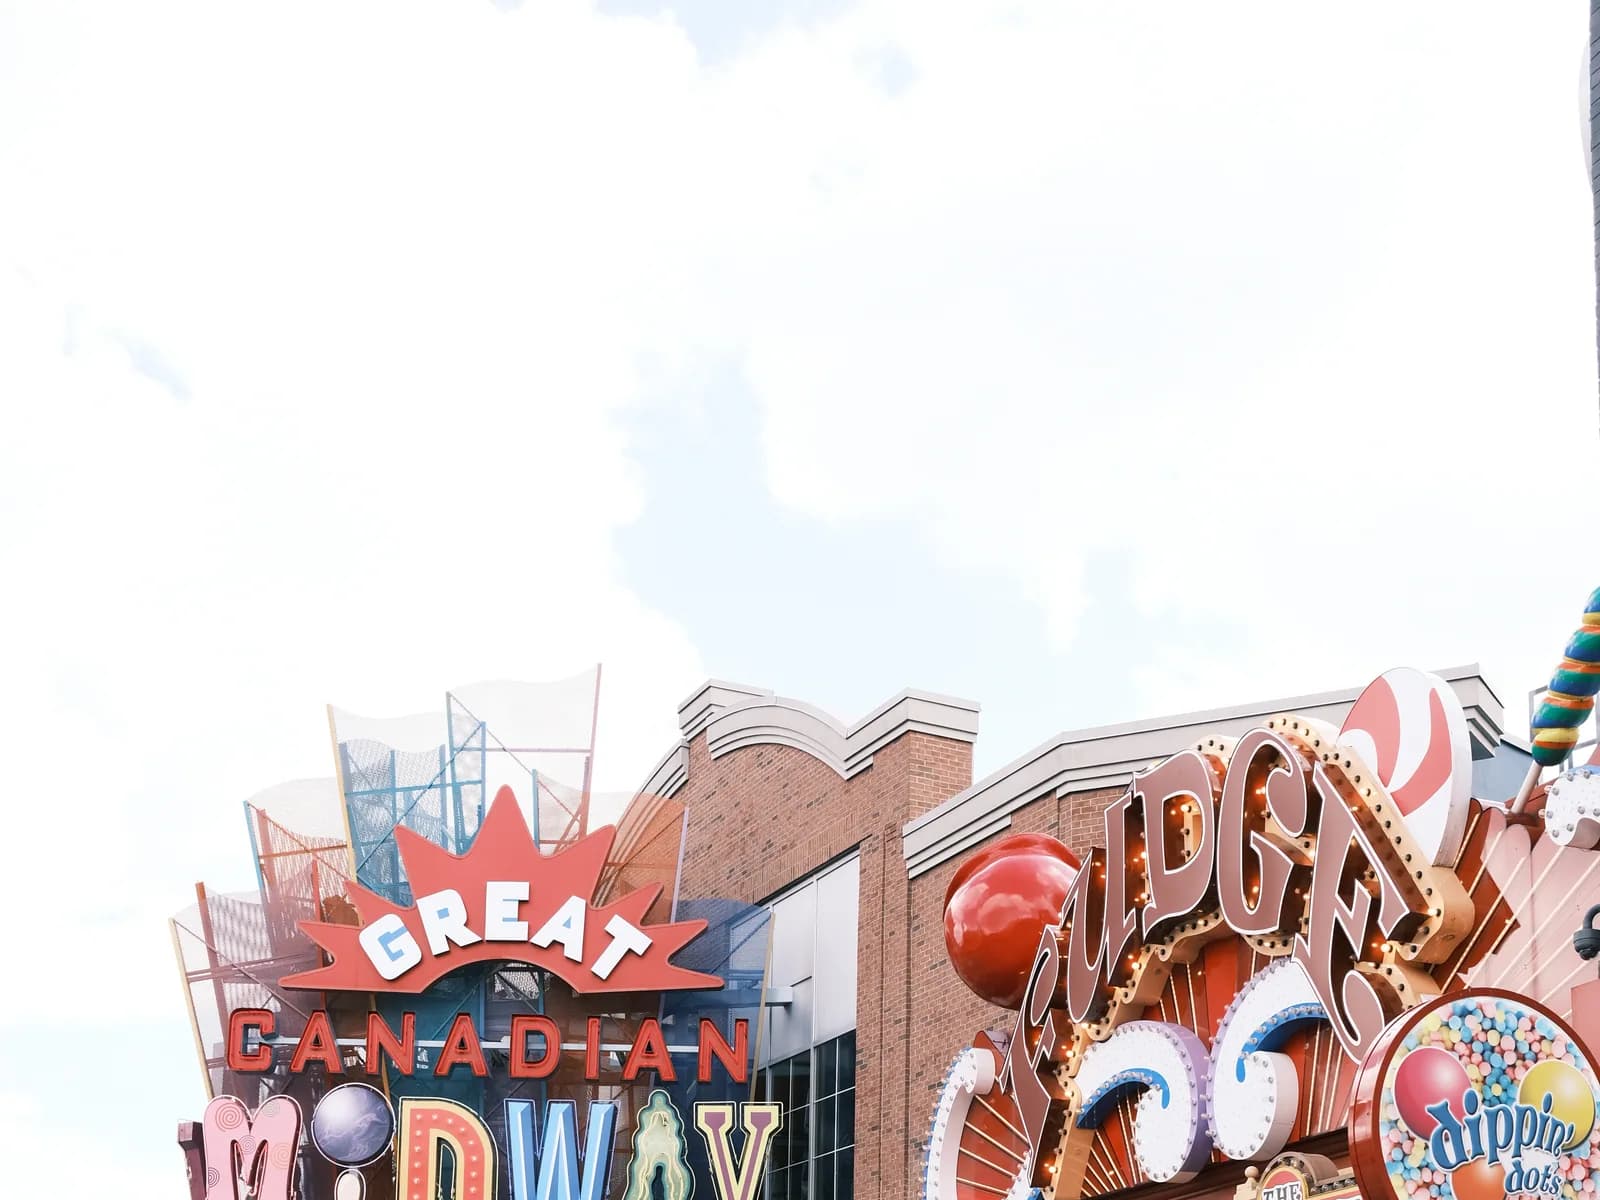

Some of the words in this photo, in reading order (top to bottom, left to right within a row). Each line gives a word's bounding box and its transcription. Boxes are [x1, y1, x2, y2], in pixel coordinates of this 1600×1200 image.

[358, 880, 653, 982] GREAT
[1001, 728, 1410, 1187] FUDGE
[225, 1006, 749, 1083] CANADIAN
[1427, 1089, 1575, 1170] dippin'
[1504, 1158, 1562, 1194] dots
